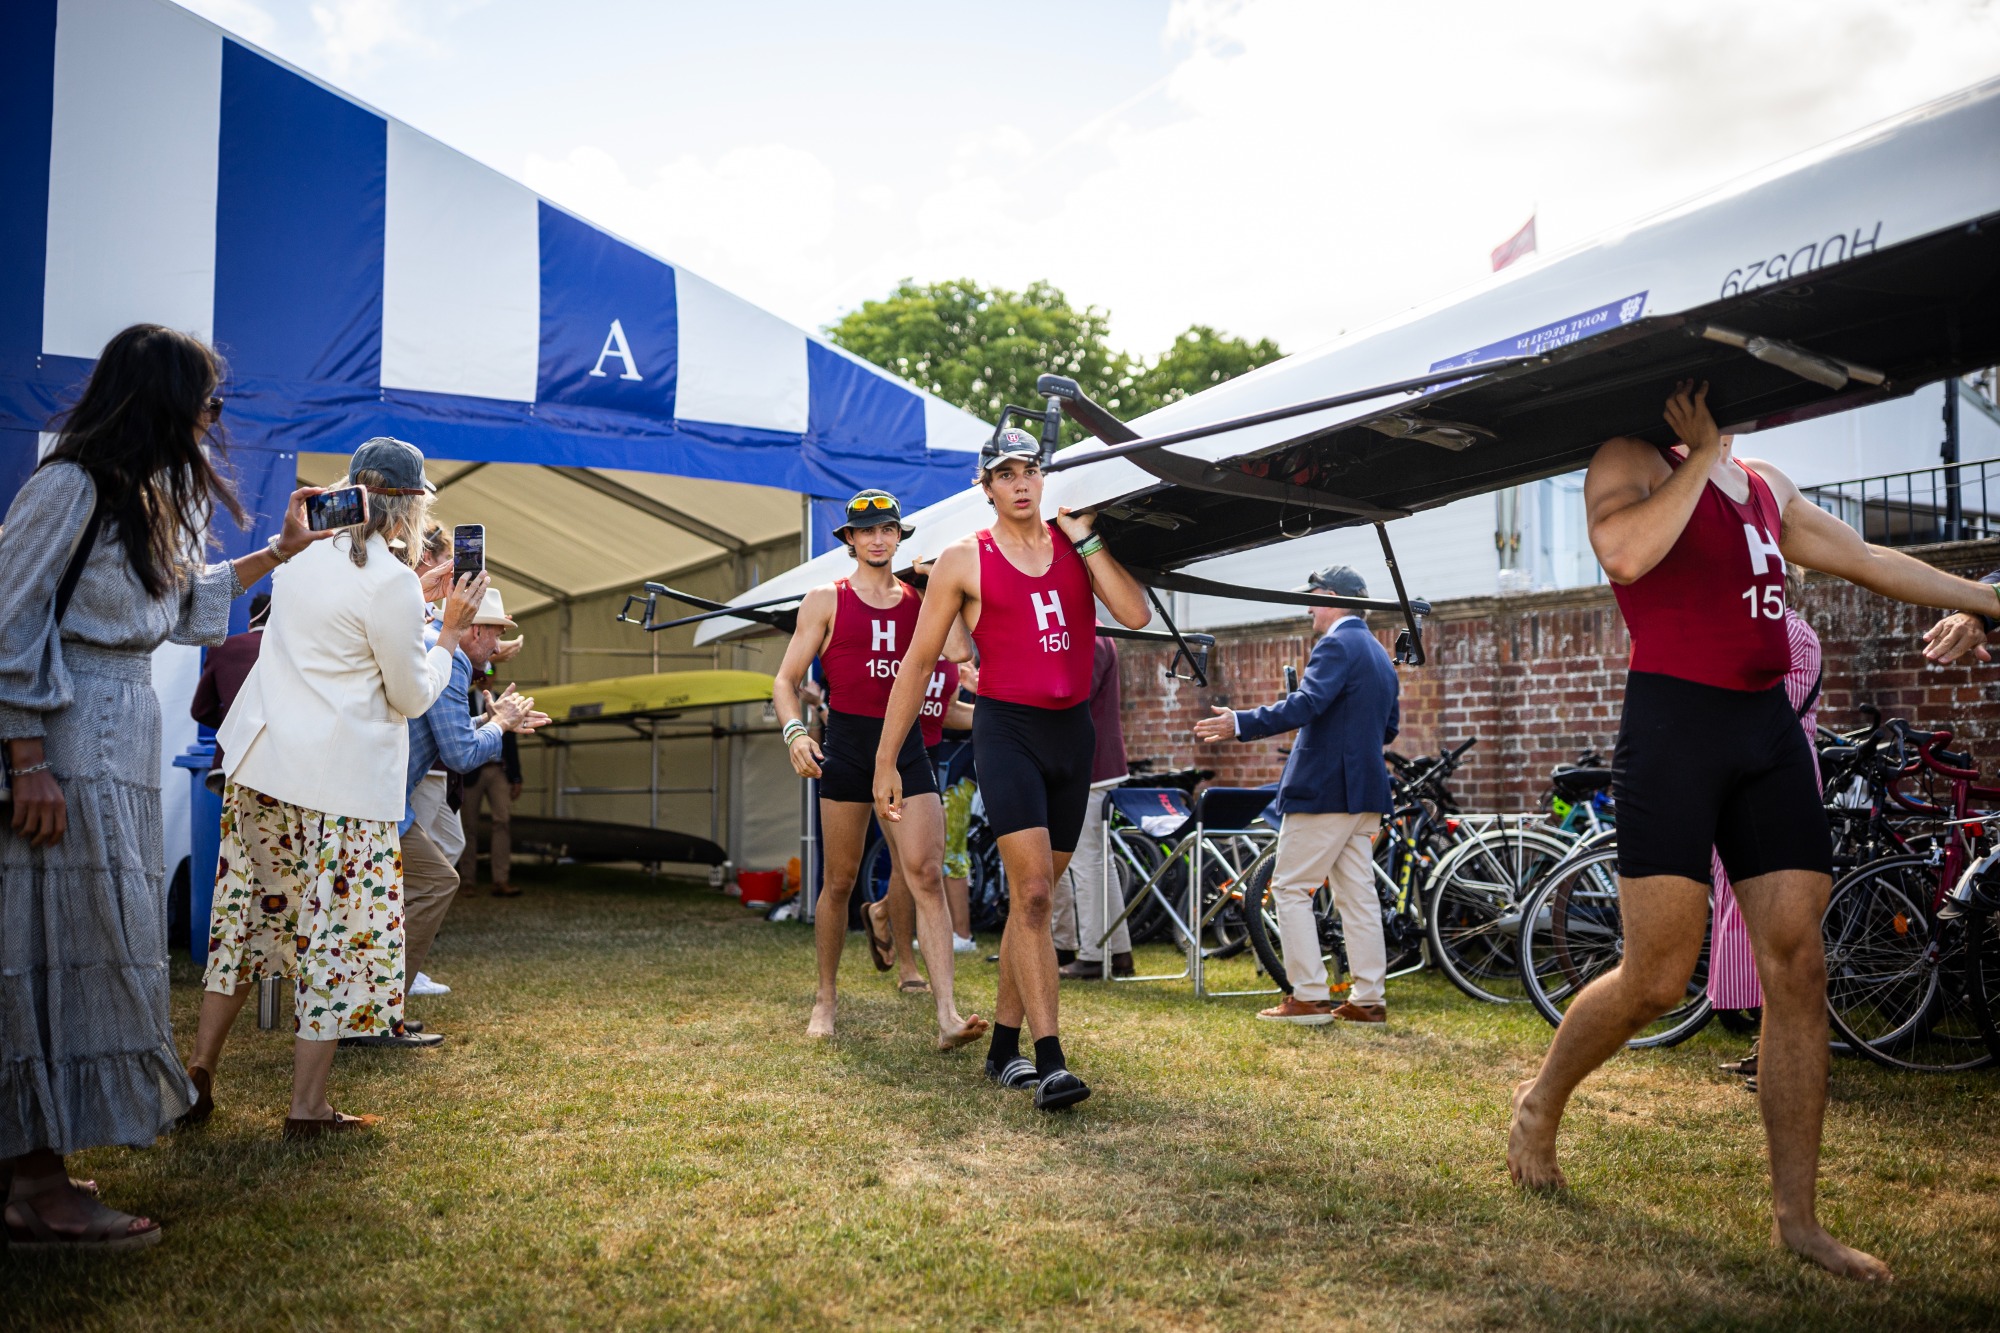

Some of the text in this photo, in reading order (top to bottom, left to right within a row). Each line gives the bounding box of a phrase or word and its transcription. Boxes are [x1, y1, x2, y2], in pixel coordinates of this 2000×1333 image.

[1517, 310, 1609, 349] ROYAL REGATTA
[589, 318, 643, 381] A
[1743, 523, 1787, 576] H
[1030, 589, 1067, 631] H
[1742, 585, 1786, 620] 15
[871, 619, 896, 652] H
[1039, 631, 1070, 653] 150
[865, 658, 902, 678] 150
[925, 671, 946, 698] H
